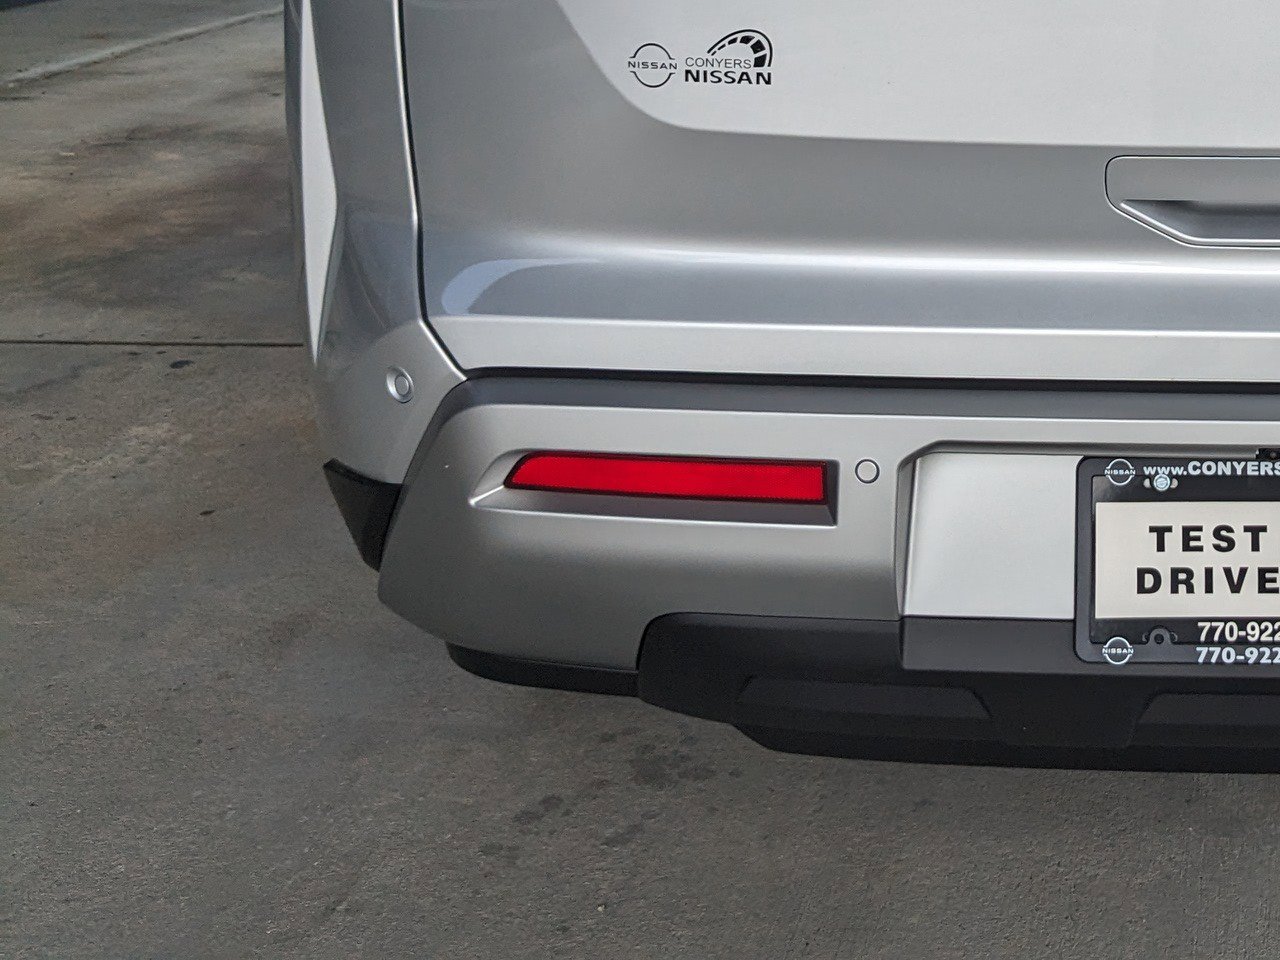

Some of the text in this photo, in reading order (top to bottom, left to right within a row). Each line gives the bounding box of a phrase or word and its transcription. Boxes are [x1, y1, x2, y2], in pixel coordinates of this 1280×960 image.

[628, 60, 678, 70] NISSAN
[685, 56, 752, 69] CONYERS
[684, 69, 772, 85] NISSAN
[1148, 524, 1268, 553] TEST
[1136, 566, 1280, 595] DRIVE
